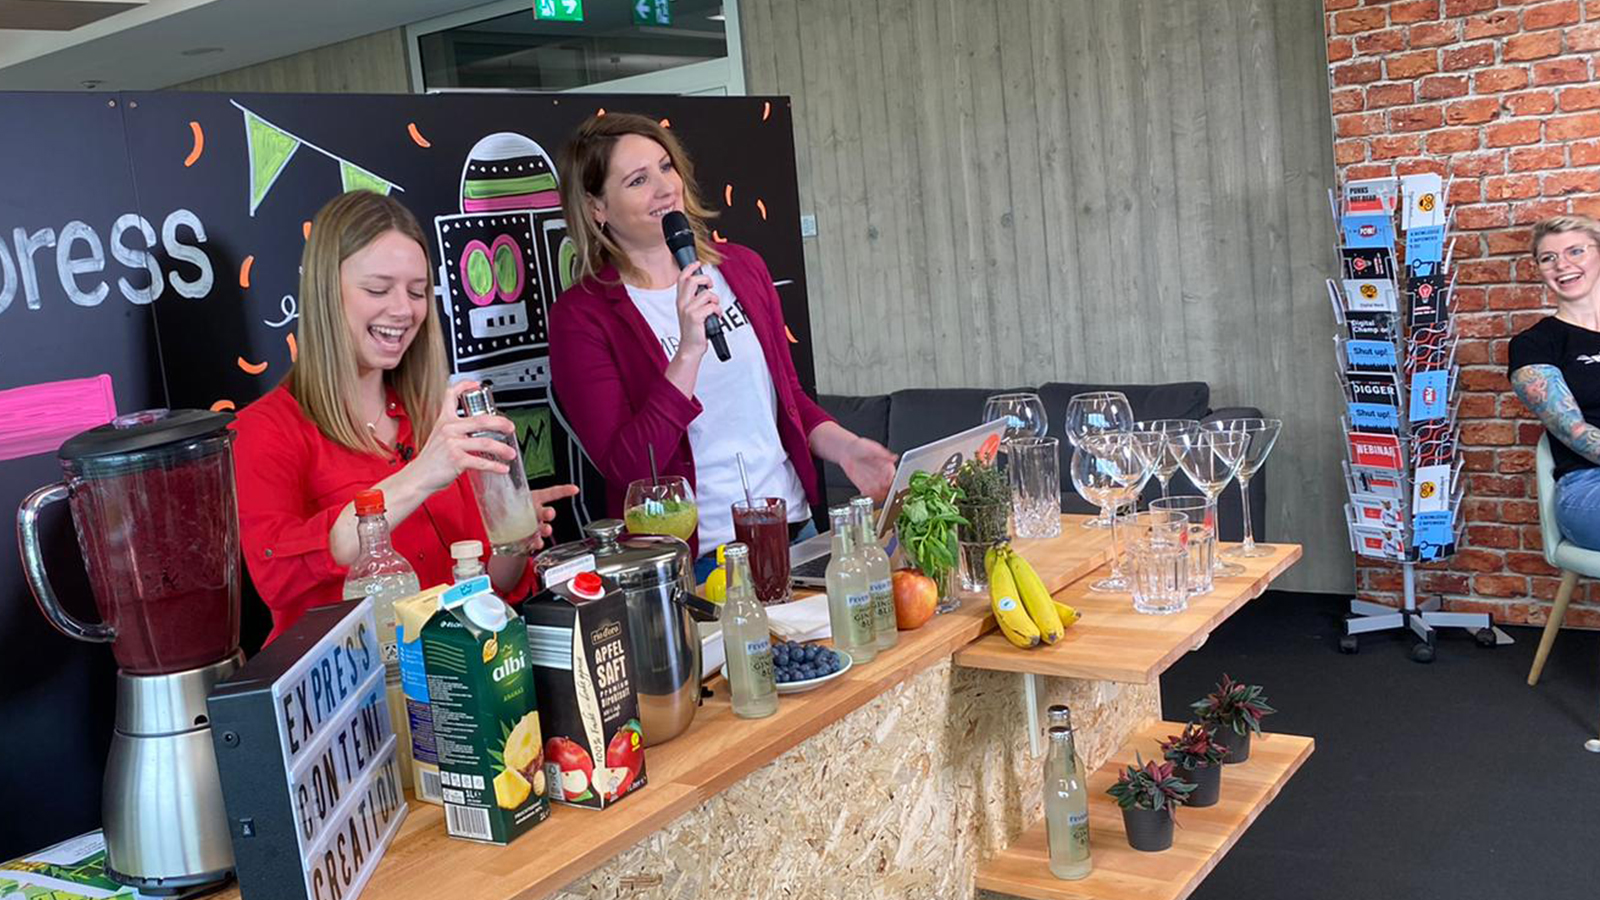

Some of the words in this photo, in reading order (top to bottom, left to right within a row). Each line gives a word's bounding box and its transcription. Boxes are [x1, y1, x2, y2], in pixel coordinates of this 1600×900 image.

[1353, 347, 1373, 355] Shut
[1353, 384, 1395, 395] DIGGER
[1356, 408, 1376, 417] Shut
[492, 650, 526, 682] albi
[595, 639, 625, 665] APFEL
[596, 655, 626, 689] SAFT
[282, 622, 372, 755] EXPRESS
[298, 692, 386, 842] CONTENT
[312, 756, 400, 900] CREATION
